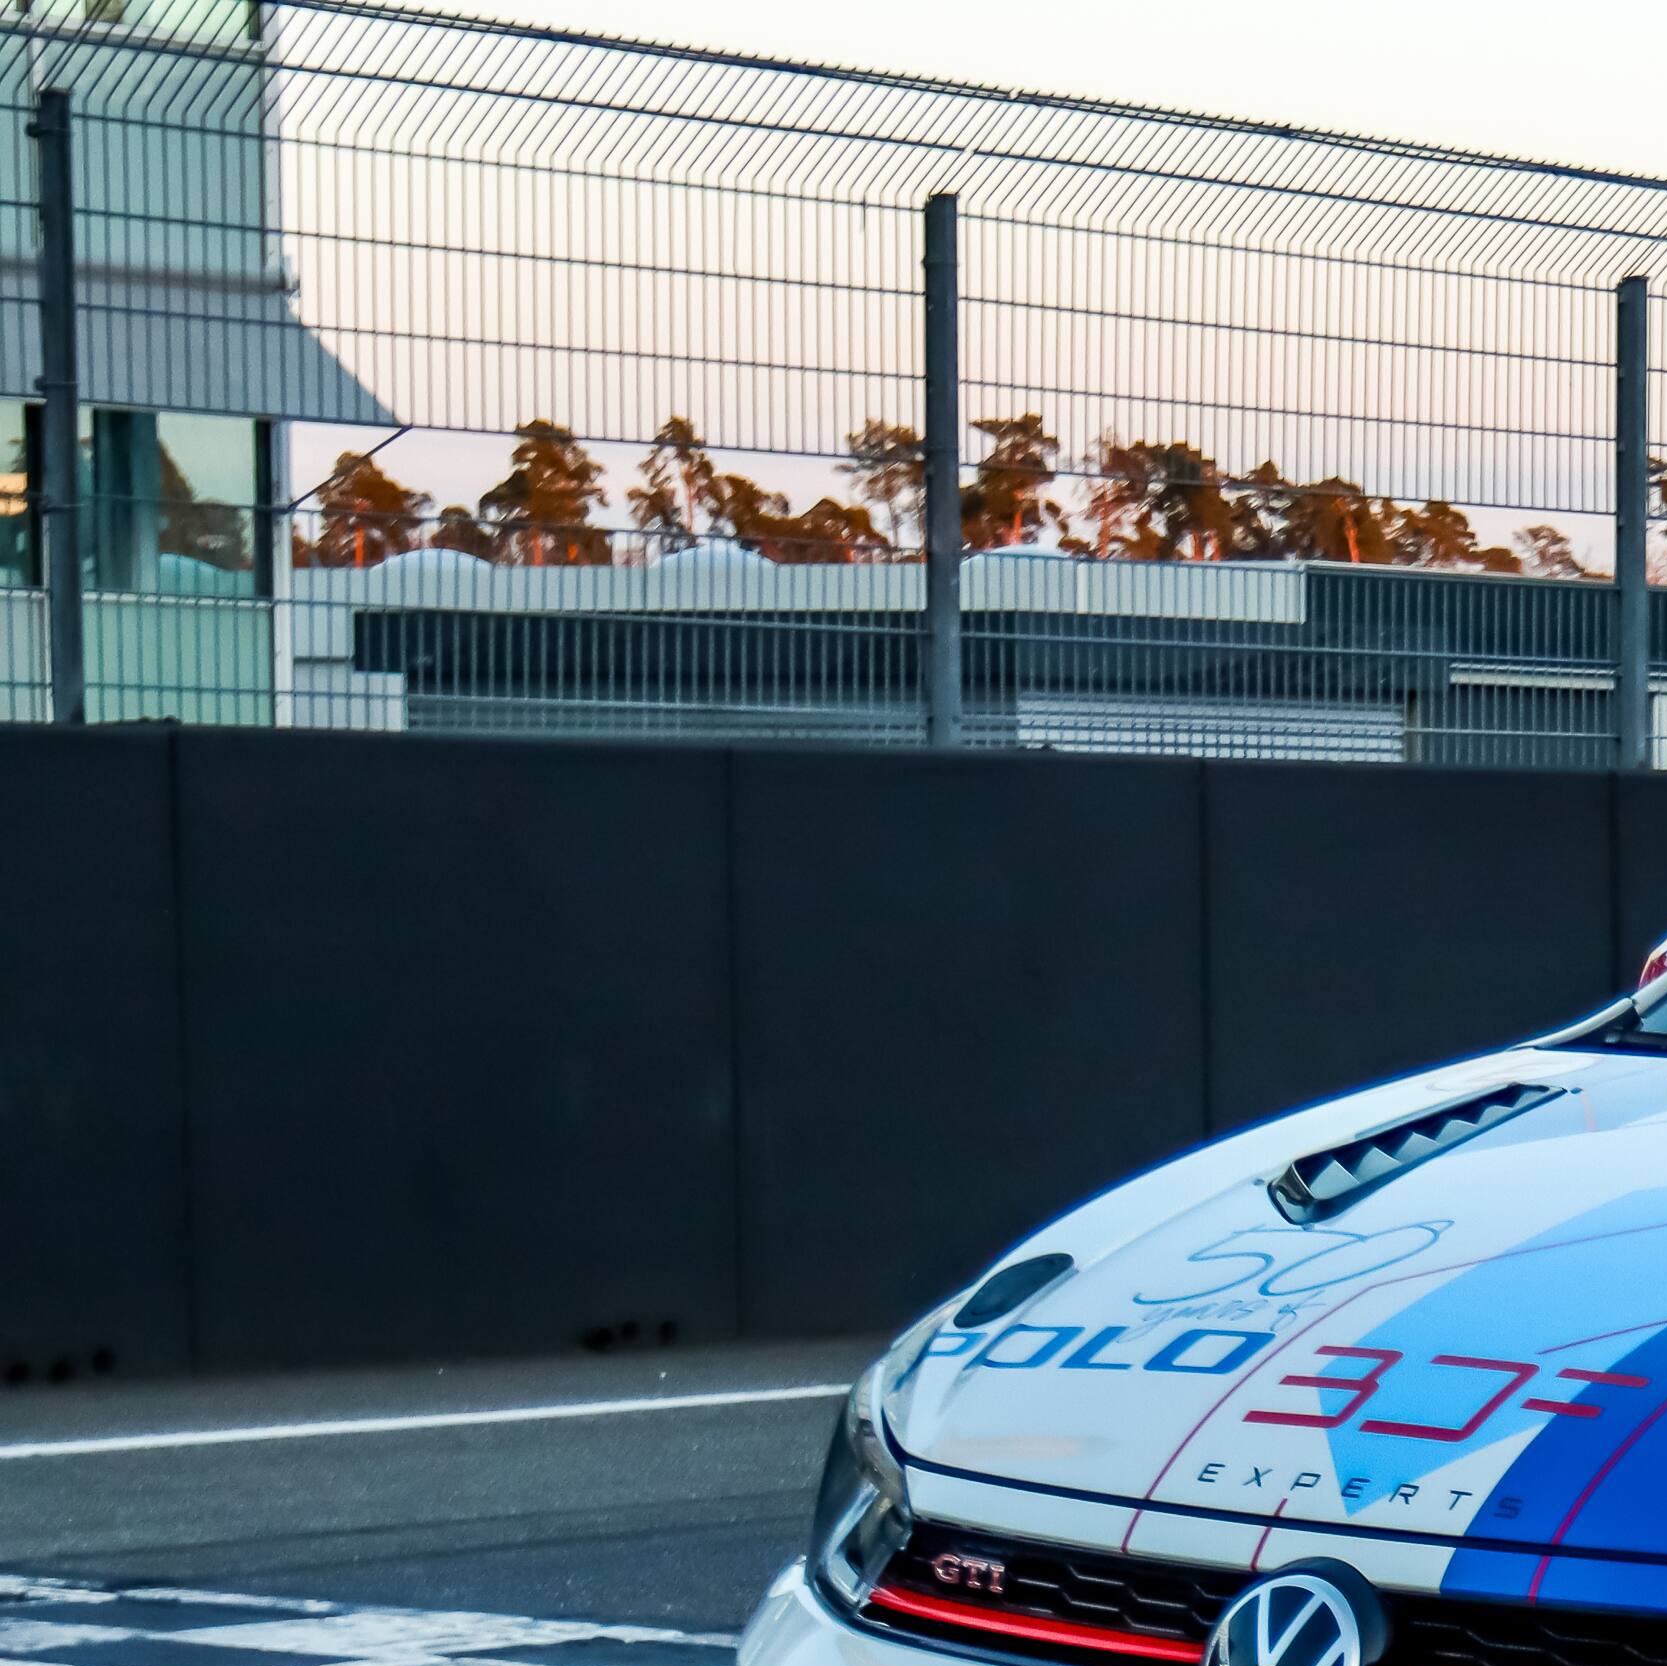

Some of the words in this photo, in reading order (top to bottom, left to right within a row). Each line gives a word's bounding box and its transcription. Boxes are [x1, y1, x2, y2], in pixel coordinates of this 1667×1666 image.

[1133, 1219, 1454, 1304] 50
[893, 1323, 1277, 1392] POLO
[1199, 1463, 1525, 1520] EXPERTS
[933, 1552, 1006, 1594] GTI
